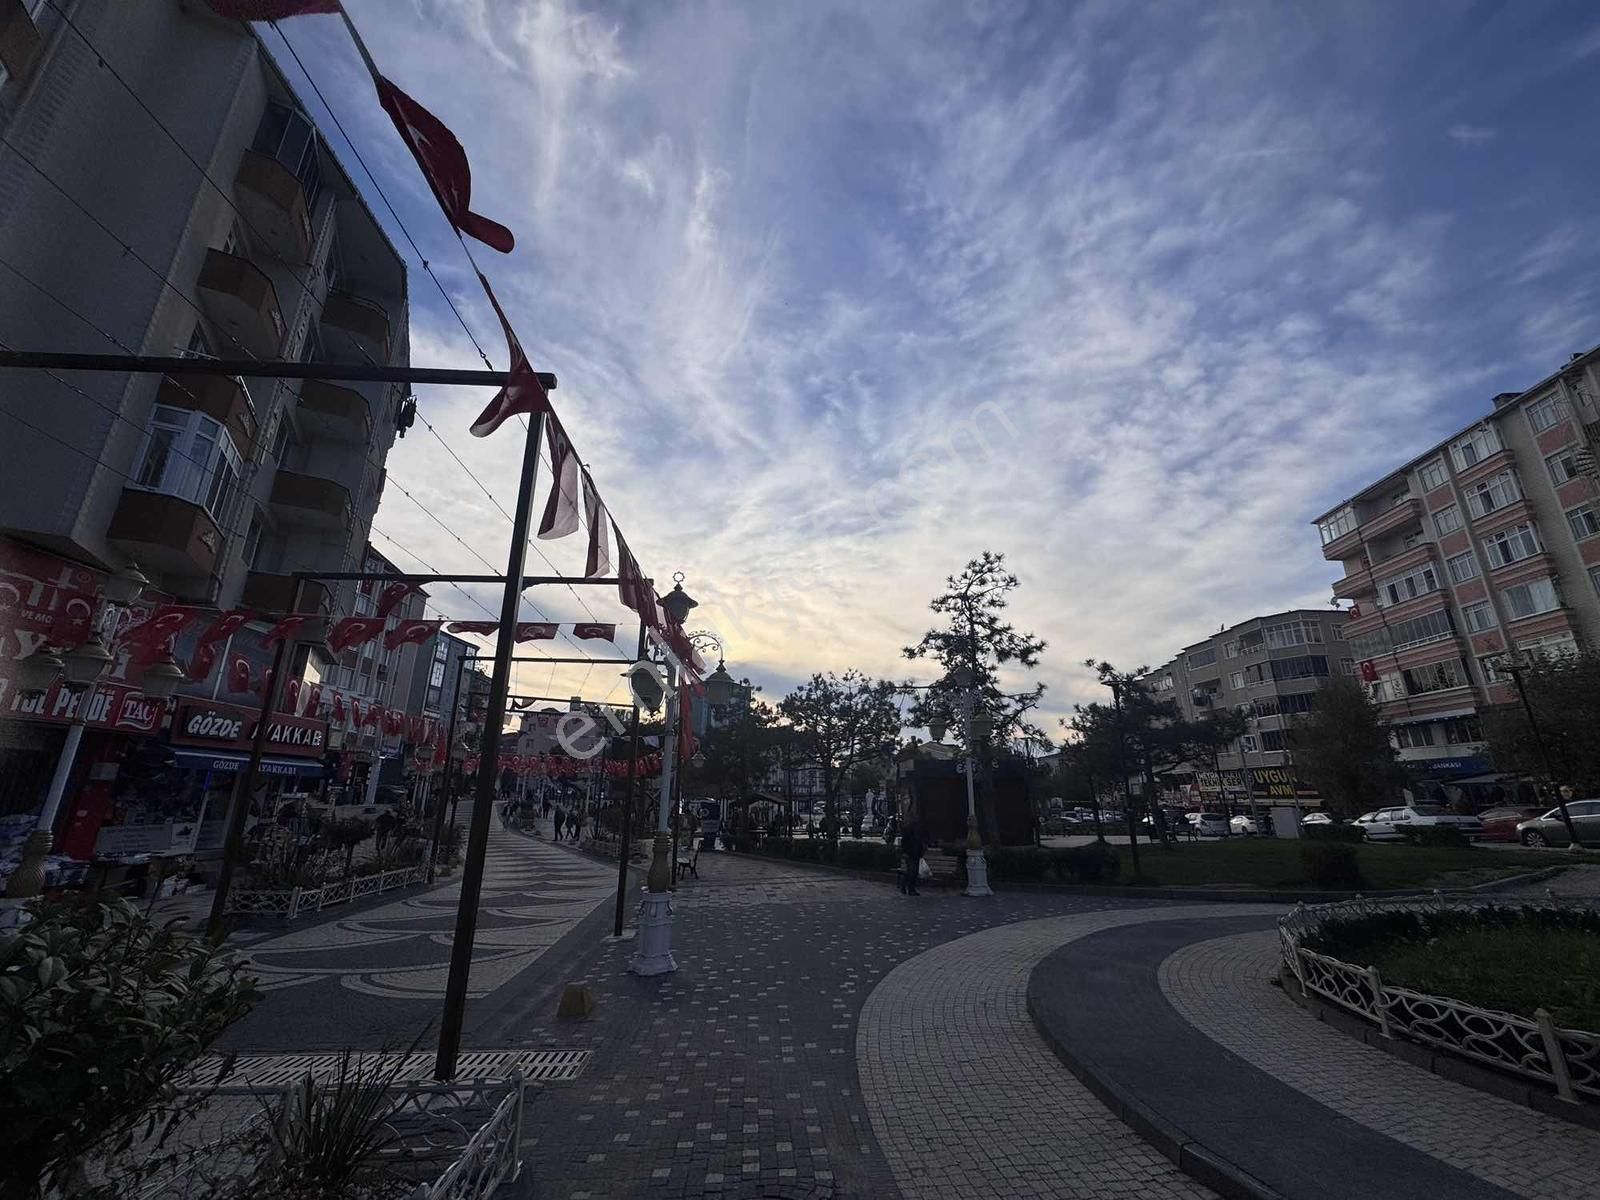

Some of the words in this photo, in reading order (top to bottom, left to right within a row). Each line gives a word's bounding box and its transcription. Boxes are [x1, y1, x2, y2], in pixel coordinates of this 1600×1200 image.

[52, 687, 114, 721] PEDE
[187, 710, 242, 738] GÖZDE
[251, 722, 322, 746] AKKAB
[212, 758, 240, 771] GÖZDE
